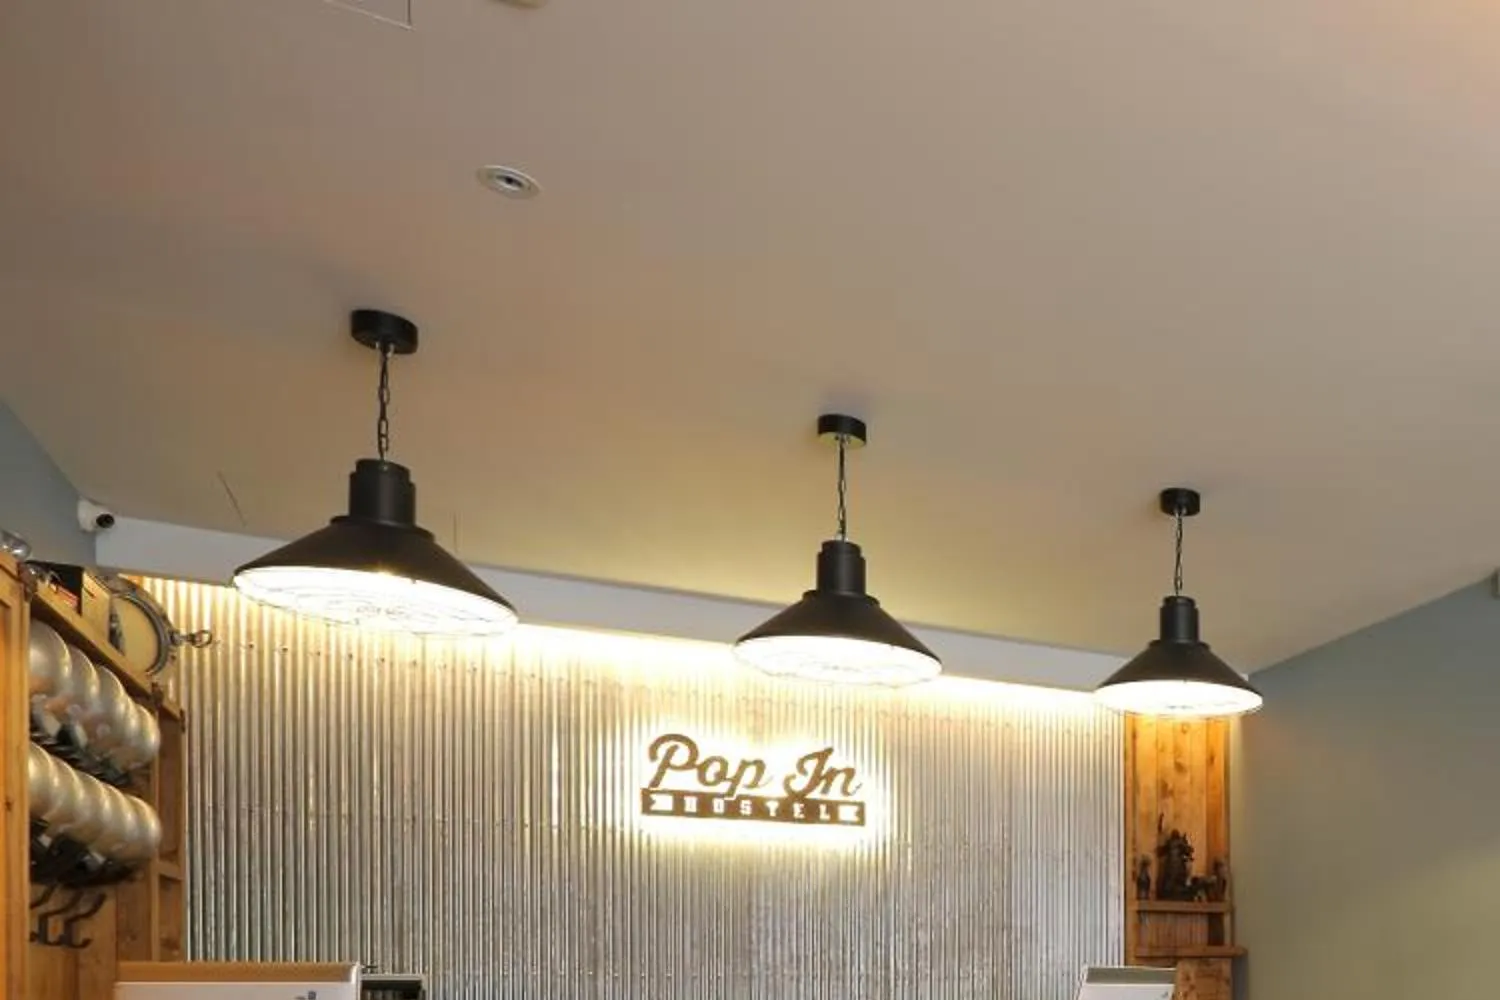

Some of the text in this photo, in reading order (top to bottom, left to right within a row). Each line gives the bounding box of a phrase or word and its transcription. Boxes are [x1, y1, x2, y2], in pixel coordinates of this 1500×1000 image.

[647, 733, 862, 799] Pop In
[683, 796, 831, 821] HOSTEL
